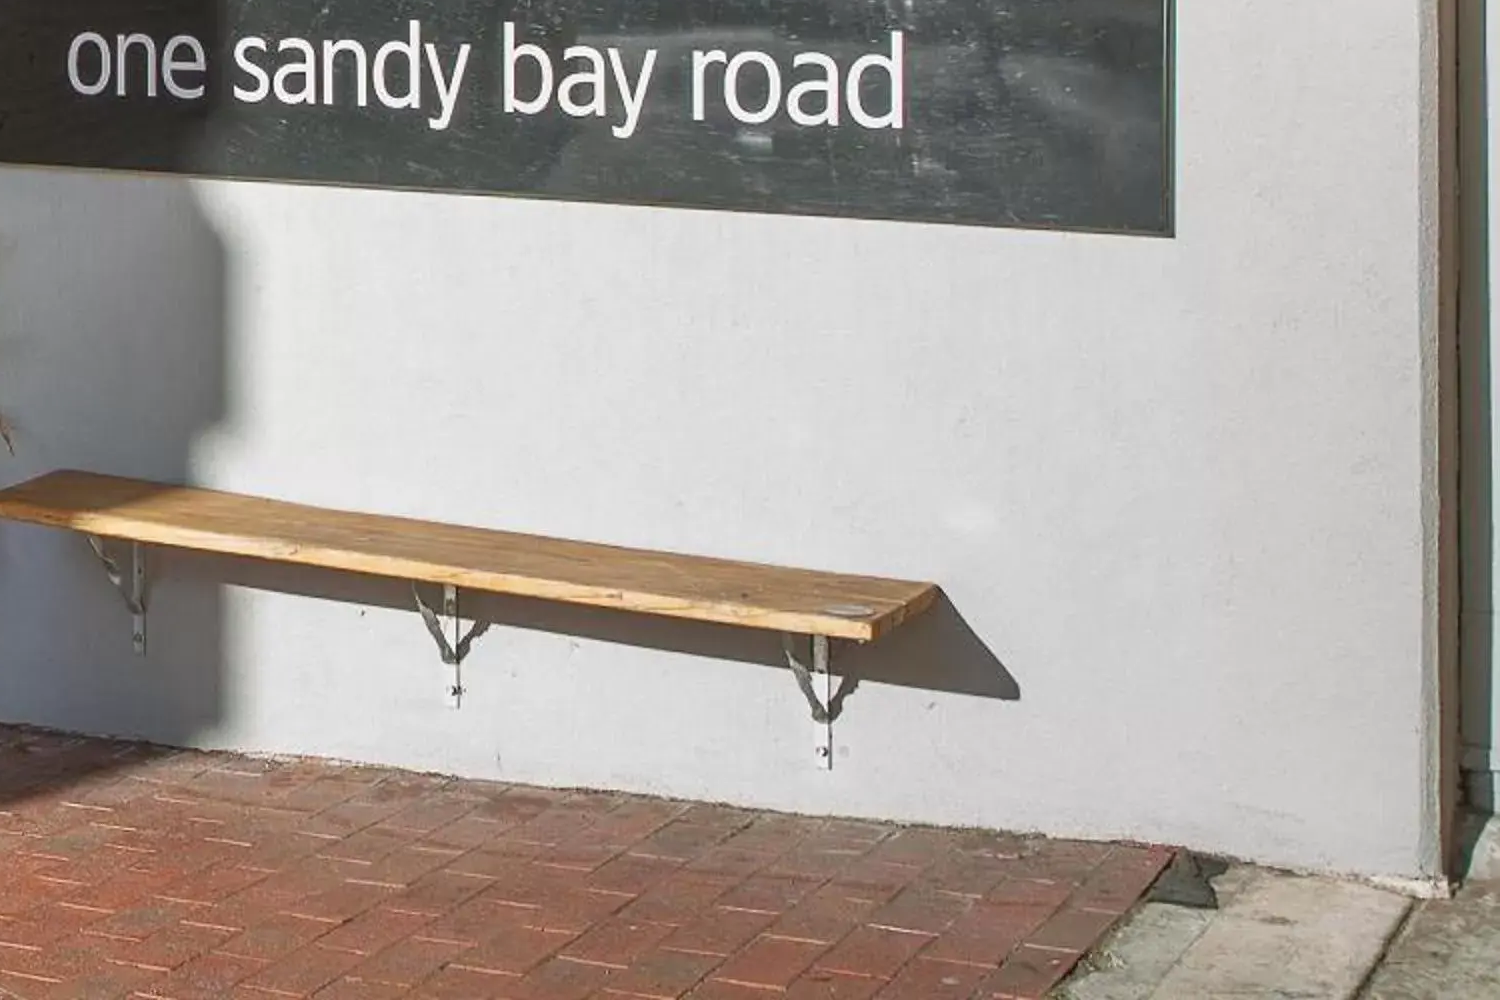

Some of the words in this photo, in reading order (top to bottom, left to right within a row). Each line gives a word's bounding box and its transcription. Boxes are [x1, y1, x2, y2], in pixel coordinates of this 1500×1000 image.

[68, 30, 207, 98] one
[233, 20, 471, 128] sandy
[503, 22, 658, 137] bay
[691, 30, 903, 129] road
